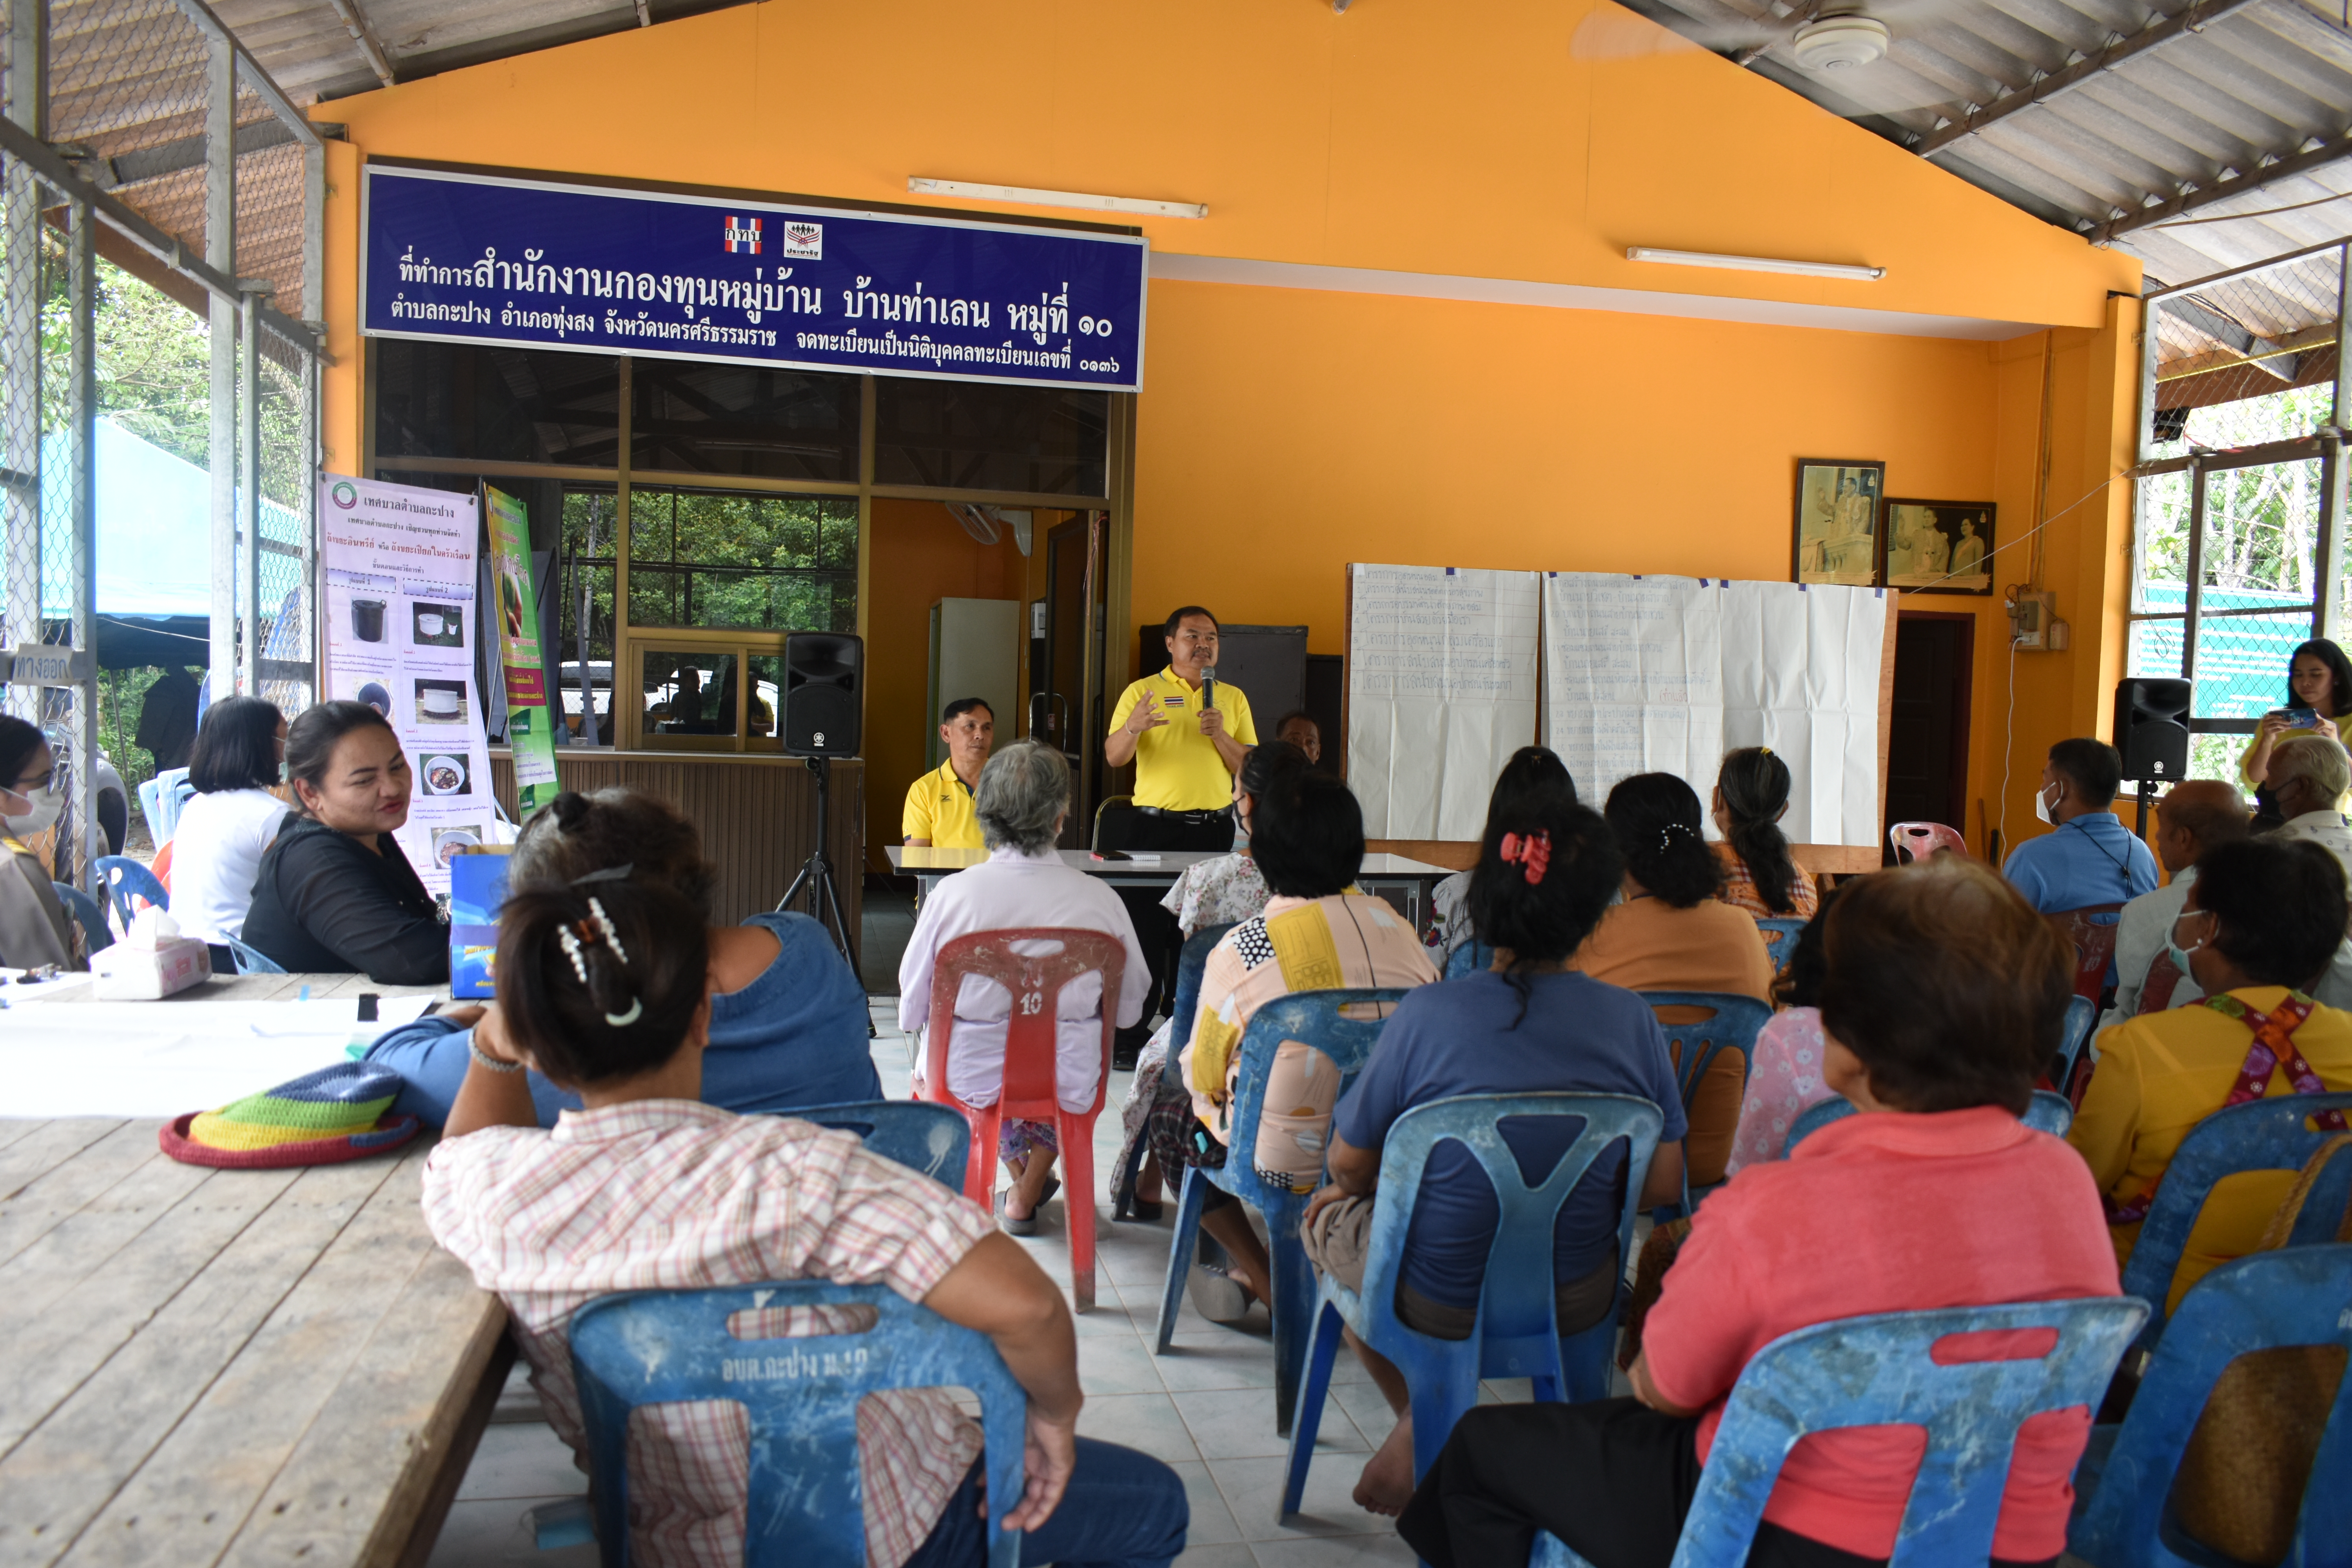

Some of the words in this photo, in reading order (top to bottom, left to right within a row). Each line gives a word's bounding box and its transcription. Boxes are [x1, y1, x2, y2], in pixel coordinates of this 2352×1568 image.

[726, 229, 762, 241] กทบ
[787, 248, 819, 256] ประชารัฐ
[843, 276, 990, 328] บ้านท่าเลน
[1007, 282, 1068, 345] หมู่ที่
[1078, 314, 1112, 337] ๑๐
[391, 293, 490, 324] ตำบลกะปาง
[501, 301, 594, 338] อำเภอทุ่งสง
[604, 309, 777, 347] จังหวัดนครศรีธรรมราช
[796, 328, 1071, 369] จดทะเบียนเป็นนิติบุคคลทะเบียนเลขที่
[1080, 356, 1120, 373] ๐๑๓๖
[364, 496, 455, 519] เทศบาลตำบลกะปาง
[348, 517, 404, 530] เทศบาลตำบลกะปาง
[406, 523, 461, 538] เชิญชวนทุกท่านจัดทำ
[327, 532, 375, 548] ถังขยะอินทรีย์
[378, 541, 389, 550] หรือ
[391, 540, 471, 560] ถังขยะเปียกในครัวเรือน
[372, 558, 425, 574] ขั้นตอนและวิธีการทำ
[16, 656, 69, 679] ทางออก
[1020, 991, 1042, 1015] 10
